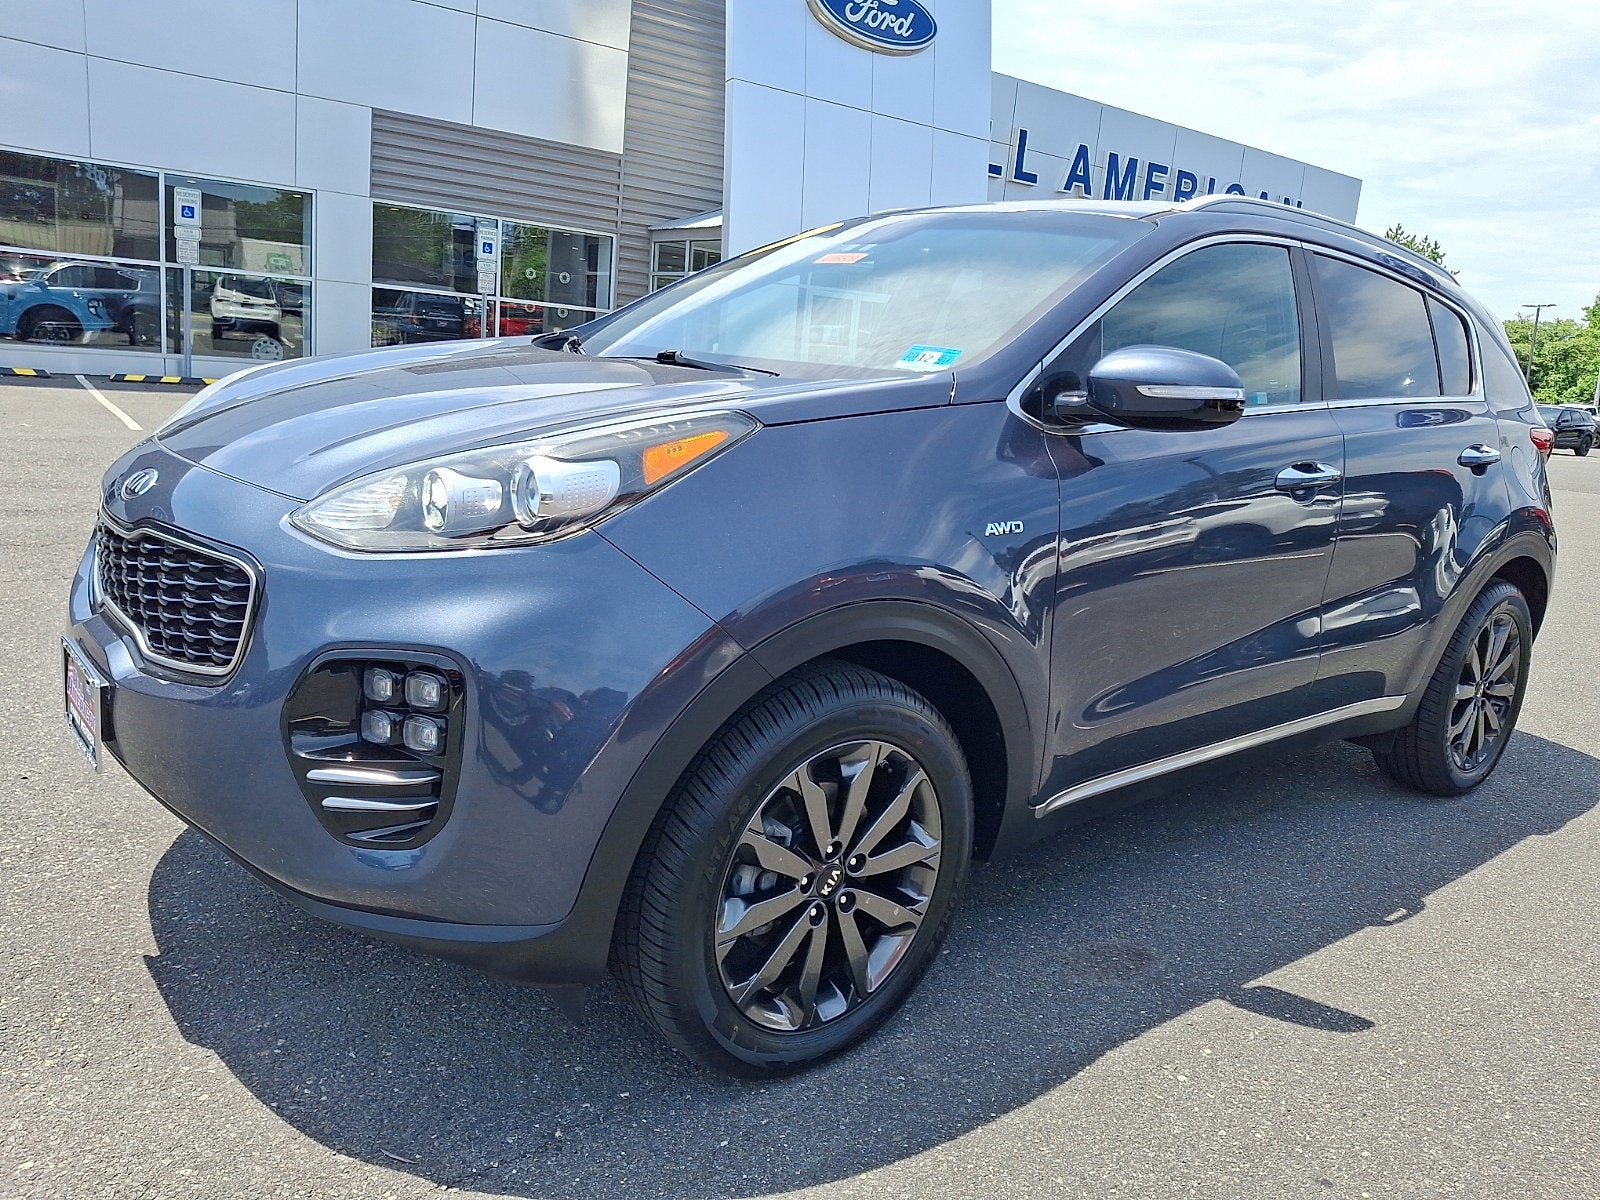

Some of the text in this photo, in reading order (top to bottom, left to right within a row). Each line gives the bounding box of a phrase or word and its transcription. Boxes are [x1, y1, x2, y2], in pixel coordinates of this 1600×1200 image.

[845, 0, 915, 37] Ford
[917, 353, 934, 362] 12
[984, 520, 1024, 537] AWD
[820, 870, 841, 896] KIA
